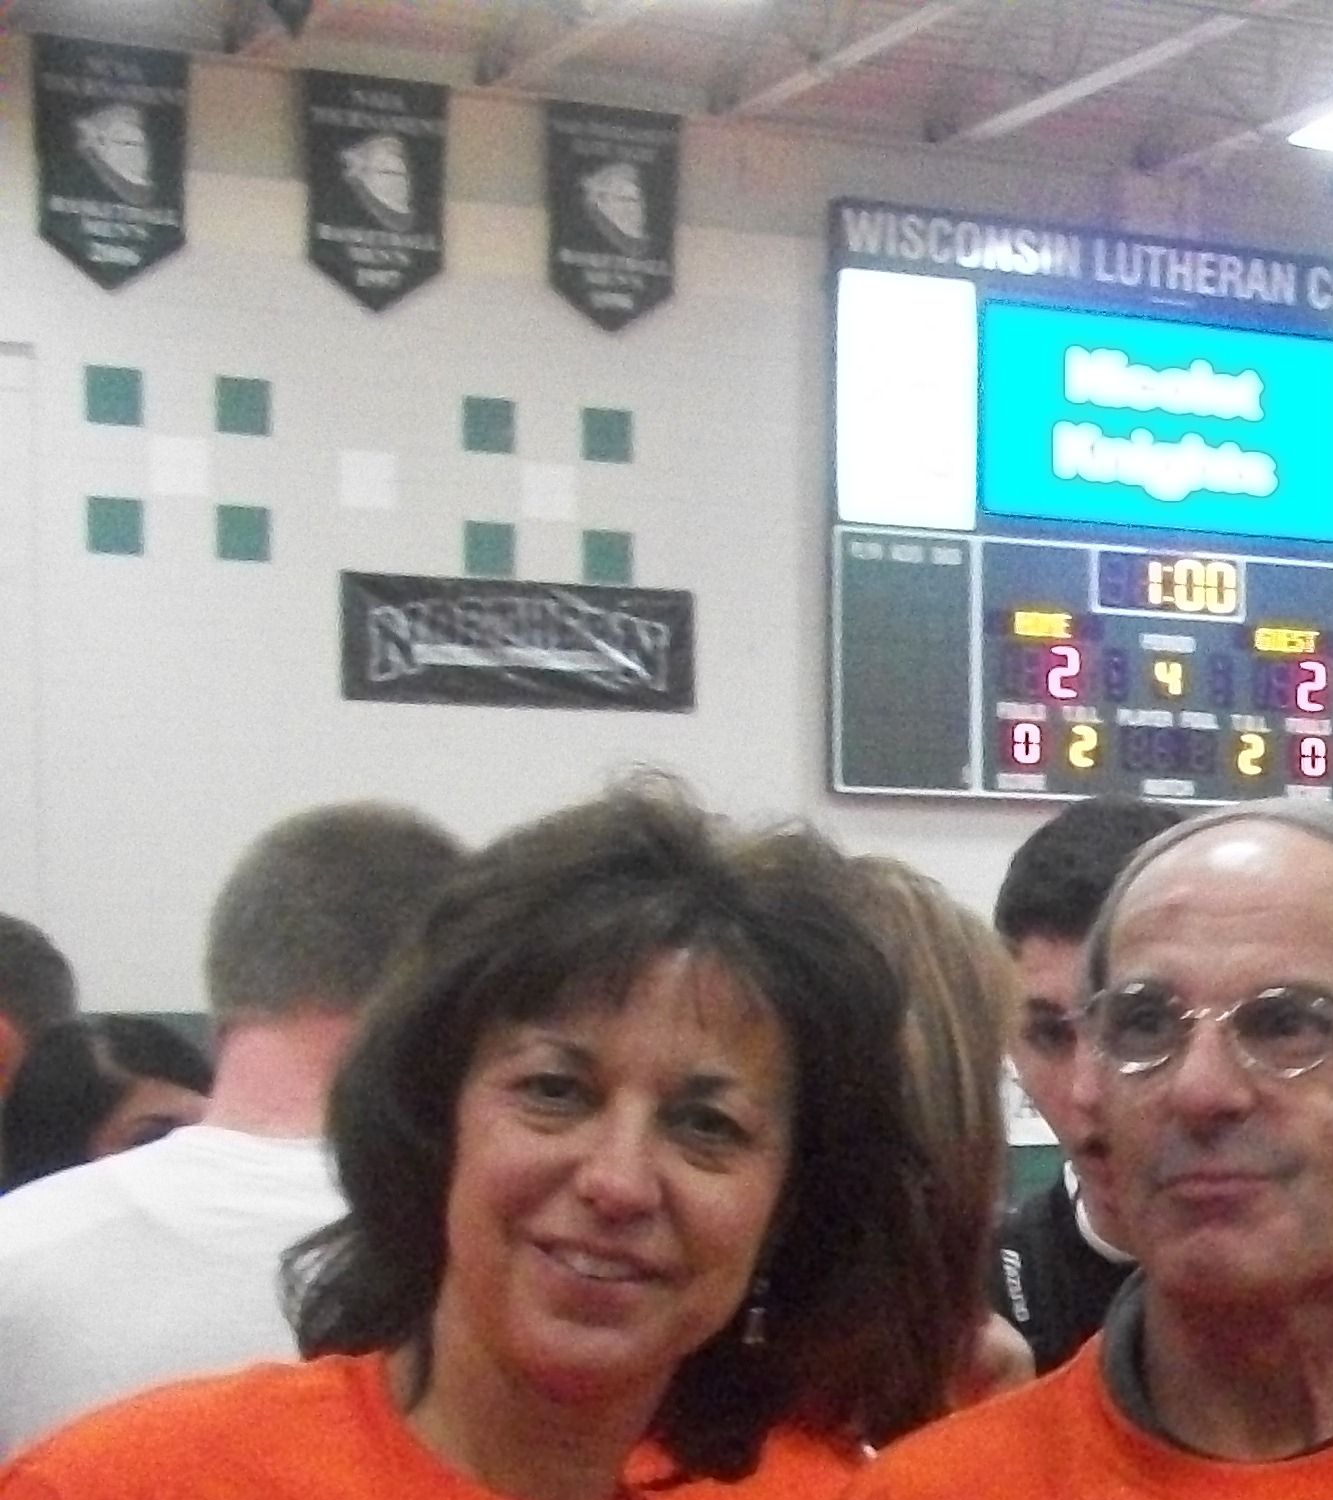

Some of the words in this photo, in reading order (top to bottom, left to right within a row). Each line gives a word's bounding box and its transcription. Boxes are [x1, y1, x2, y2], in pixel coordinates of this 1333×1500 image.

[842, 207, 1083, 279] WISCONSIN
[1095, 236, 1297, 306] LUTHERAN
[1149, 559, 1237, 614] 1:00
[1047, 645, 1082, 699] 2
[1154, 661, 1183, 696] 4
[1295, 661, 1327, 712] 2
[1012, 723, 1041, 765] 0
[1069, 724, 1098, 768] 2
[1237, 733, 1266, 775] 2
[1300, 737, 1328, 777] 0
